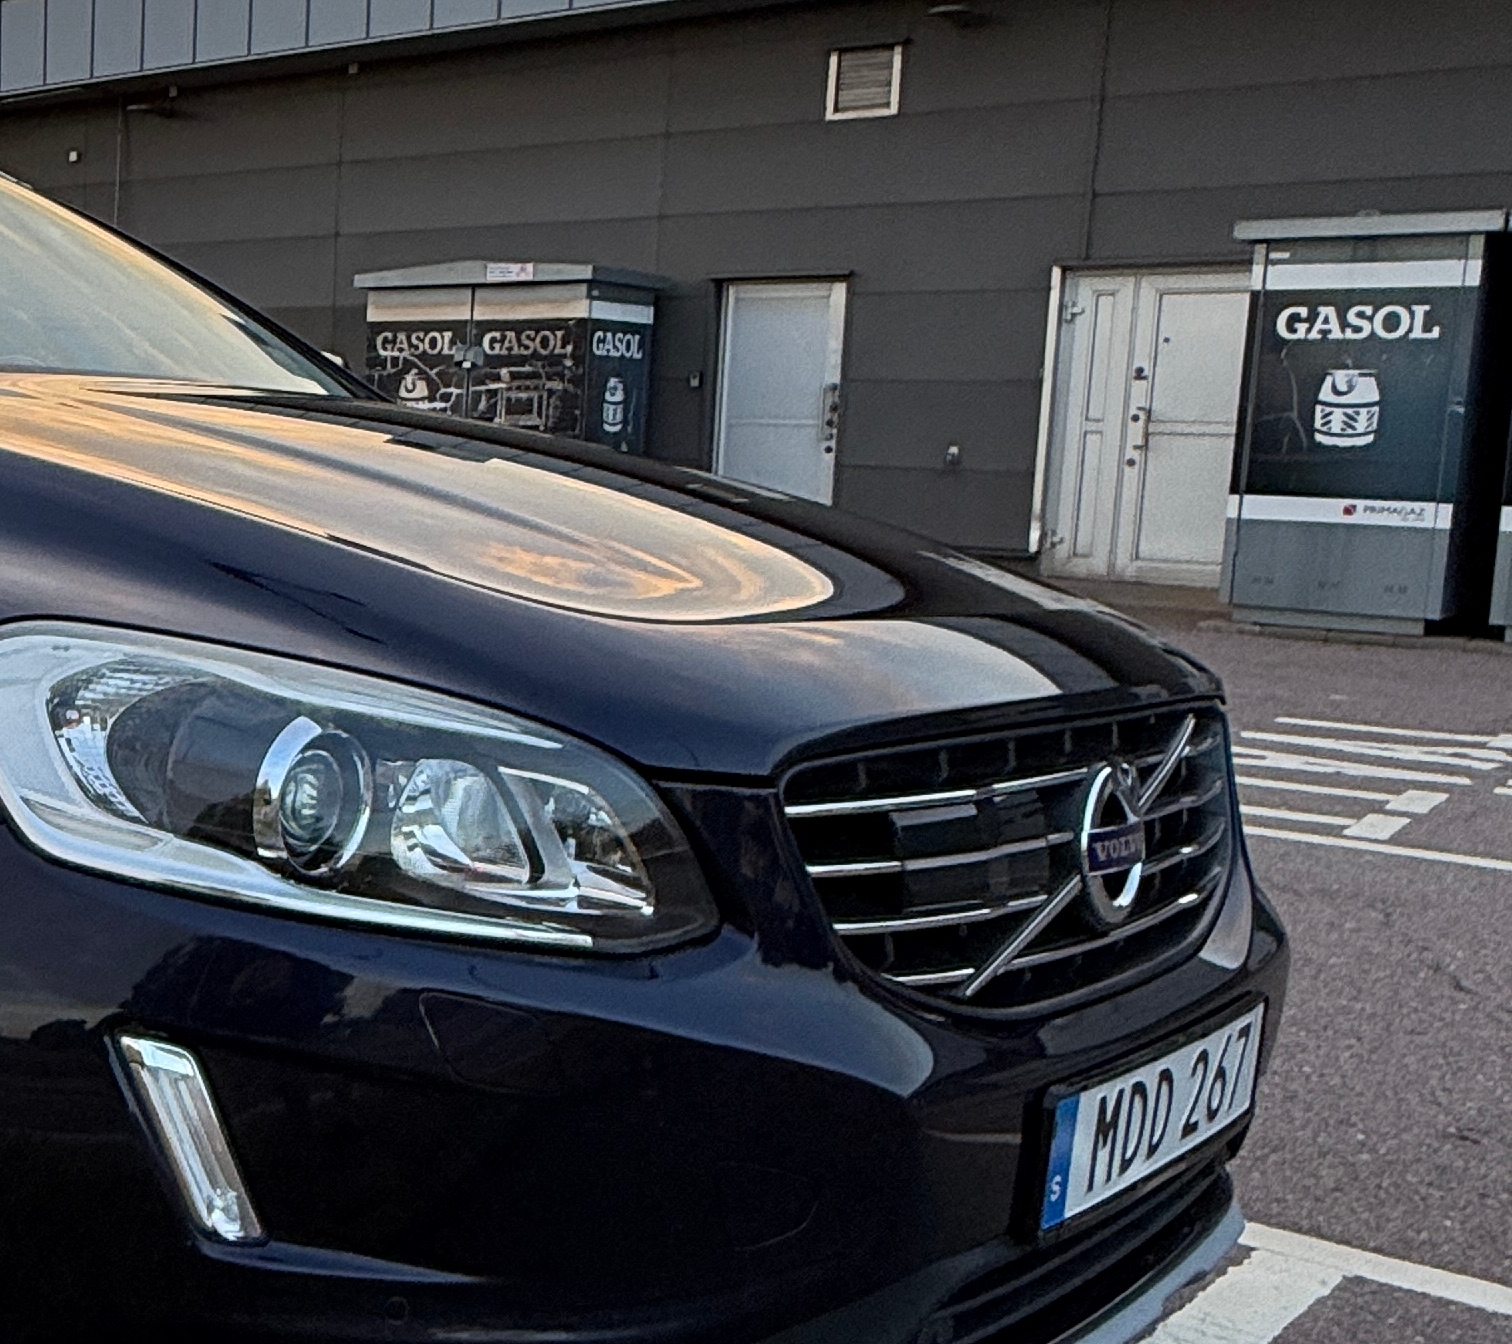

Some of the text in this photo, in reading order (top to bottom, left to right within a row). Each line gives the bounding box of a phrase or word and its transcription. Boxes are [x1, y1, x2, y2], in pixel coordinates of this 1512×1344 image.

[1276, 305, 1440, 340] GASOL
[376, 331, 456, 356] GASOL
[482, 330, 572, 355] GASOL
[592, 330, 643, 360] GASOL
[1086, 1020, 1253, 1195] MDD 267
[1050, 1174, 1062, 1202] S
